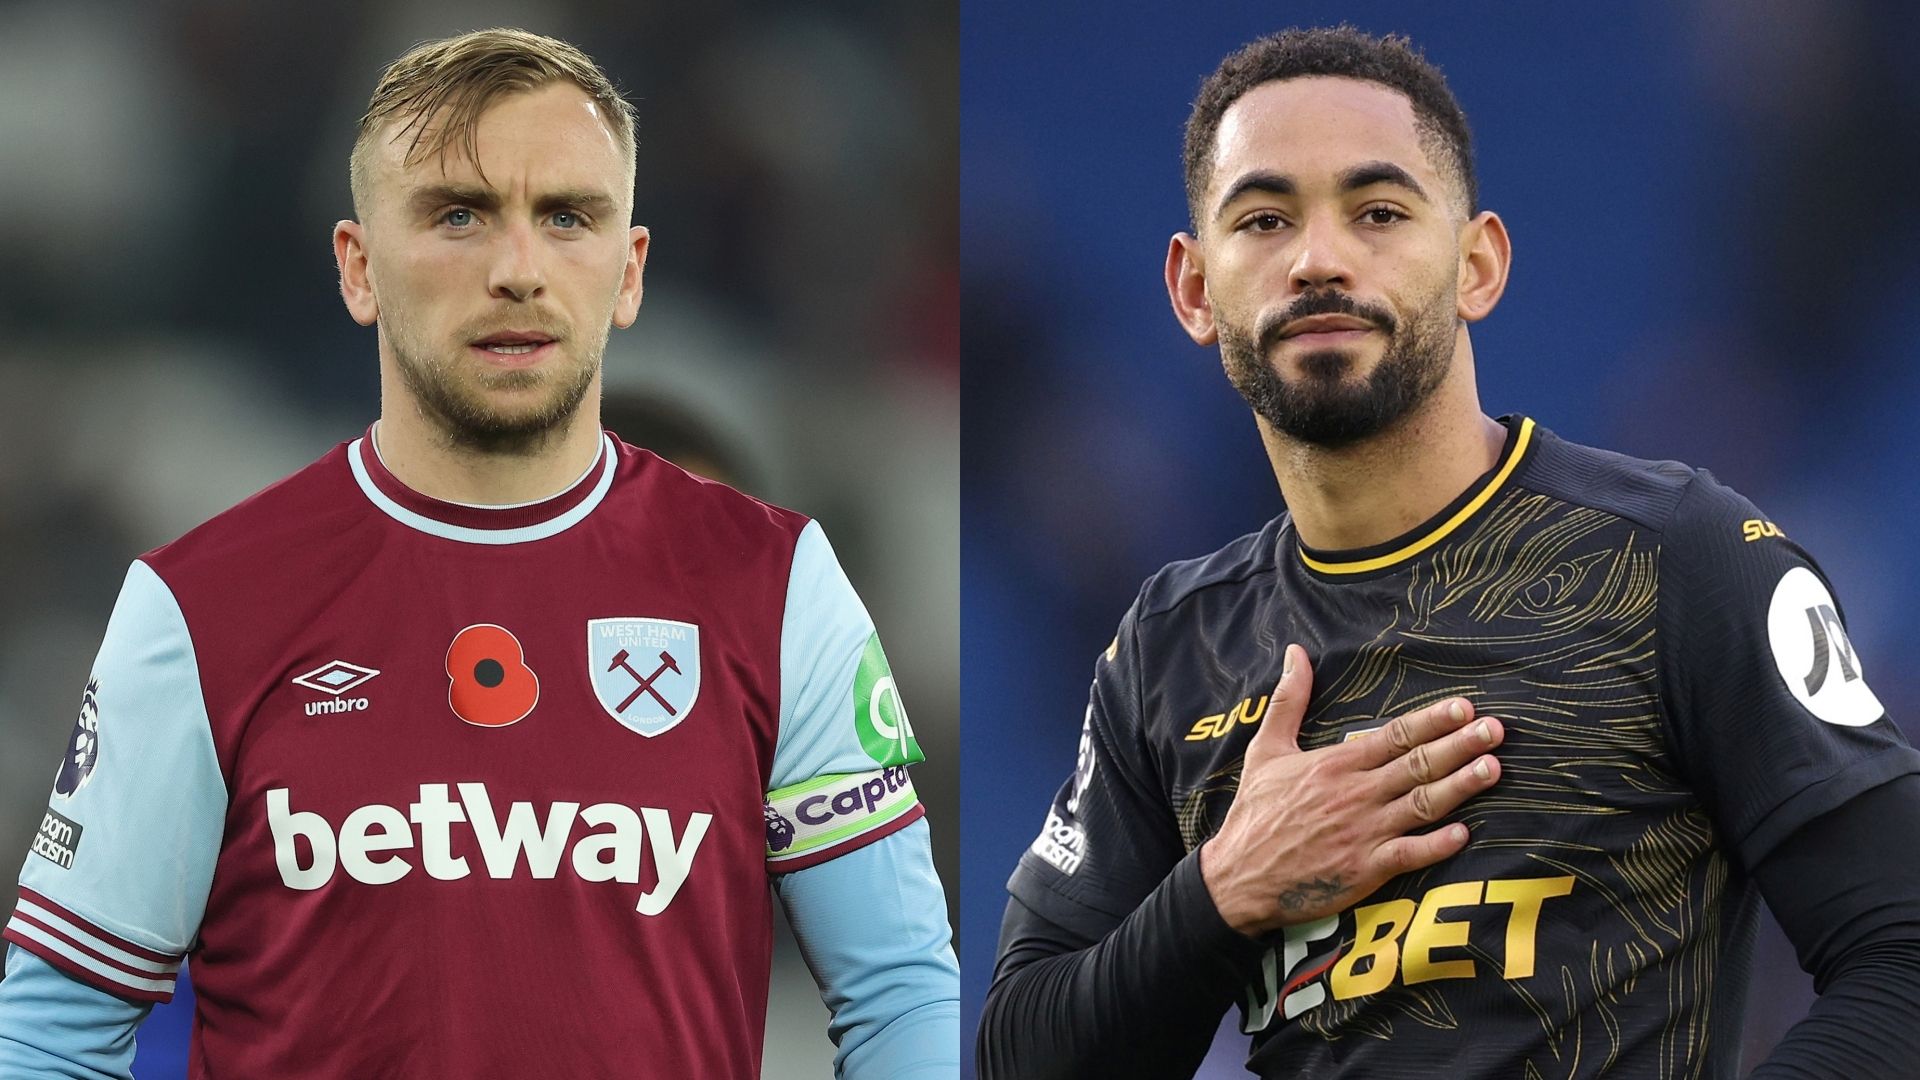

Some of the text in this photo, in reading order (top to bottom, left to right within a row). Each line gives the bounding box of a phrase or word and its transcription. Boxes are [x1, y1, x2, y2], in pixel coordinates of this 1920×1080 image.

[600, 624, 686, 641] WEST HAM
[619, 636, 668, 649] UNITED
[305, 696, 369, 716] umbro
[628, 713, 665, 725] LONDON
[266, 782, 713, 917] betway
